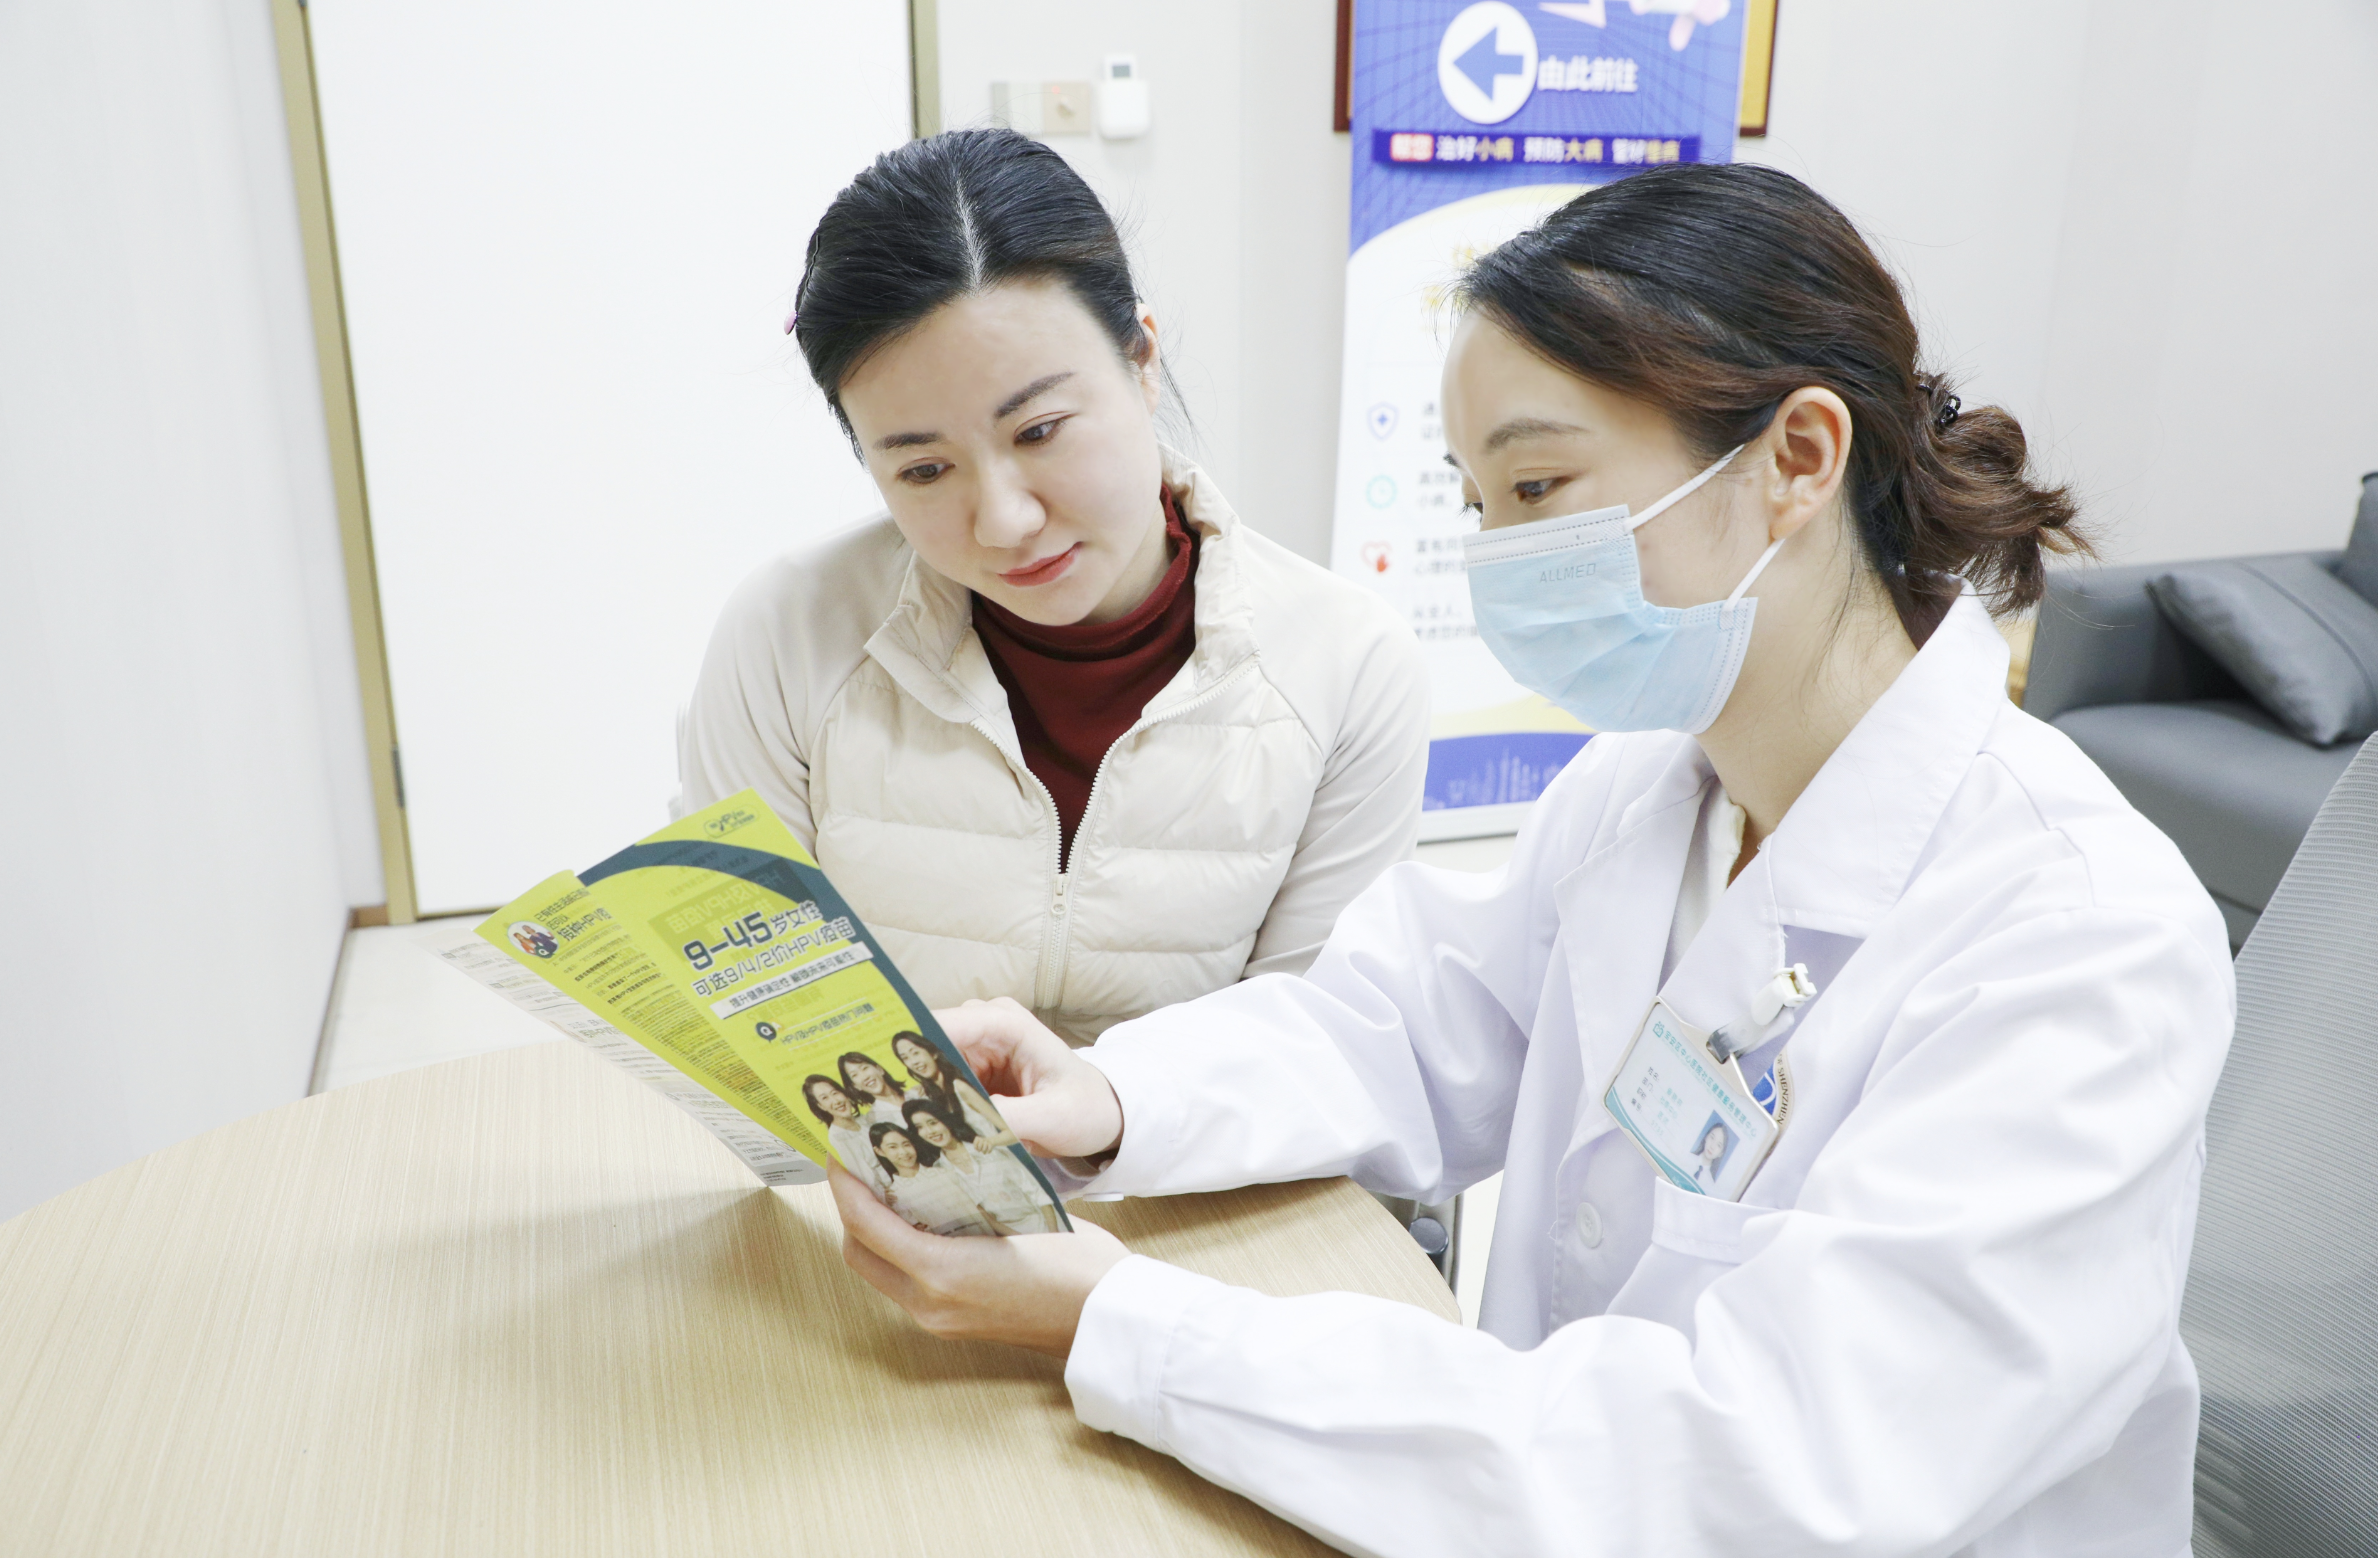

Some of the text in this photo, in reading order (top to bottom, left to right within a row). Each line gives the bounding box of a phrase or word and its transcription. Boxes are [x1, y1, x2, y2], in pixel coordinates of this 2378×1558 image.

[1537, 55, 1639, 93] 由此前往
[1436, 136, 1514, 162] 治好小病
[1523, 137, 1603, 163] 预防大病
[1539, 562, 1597, 584] ALLMED
[691, 916, 855, 997] 可选9/4/2价HPV疫苗
[1777, 1066, 1789, 1125] SHENZHEN
